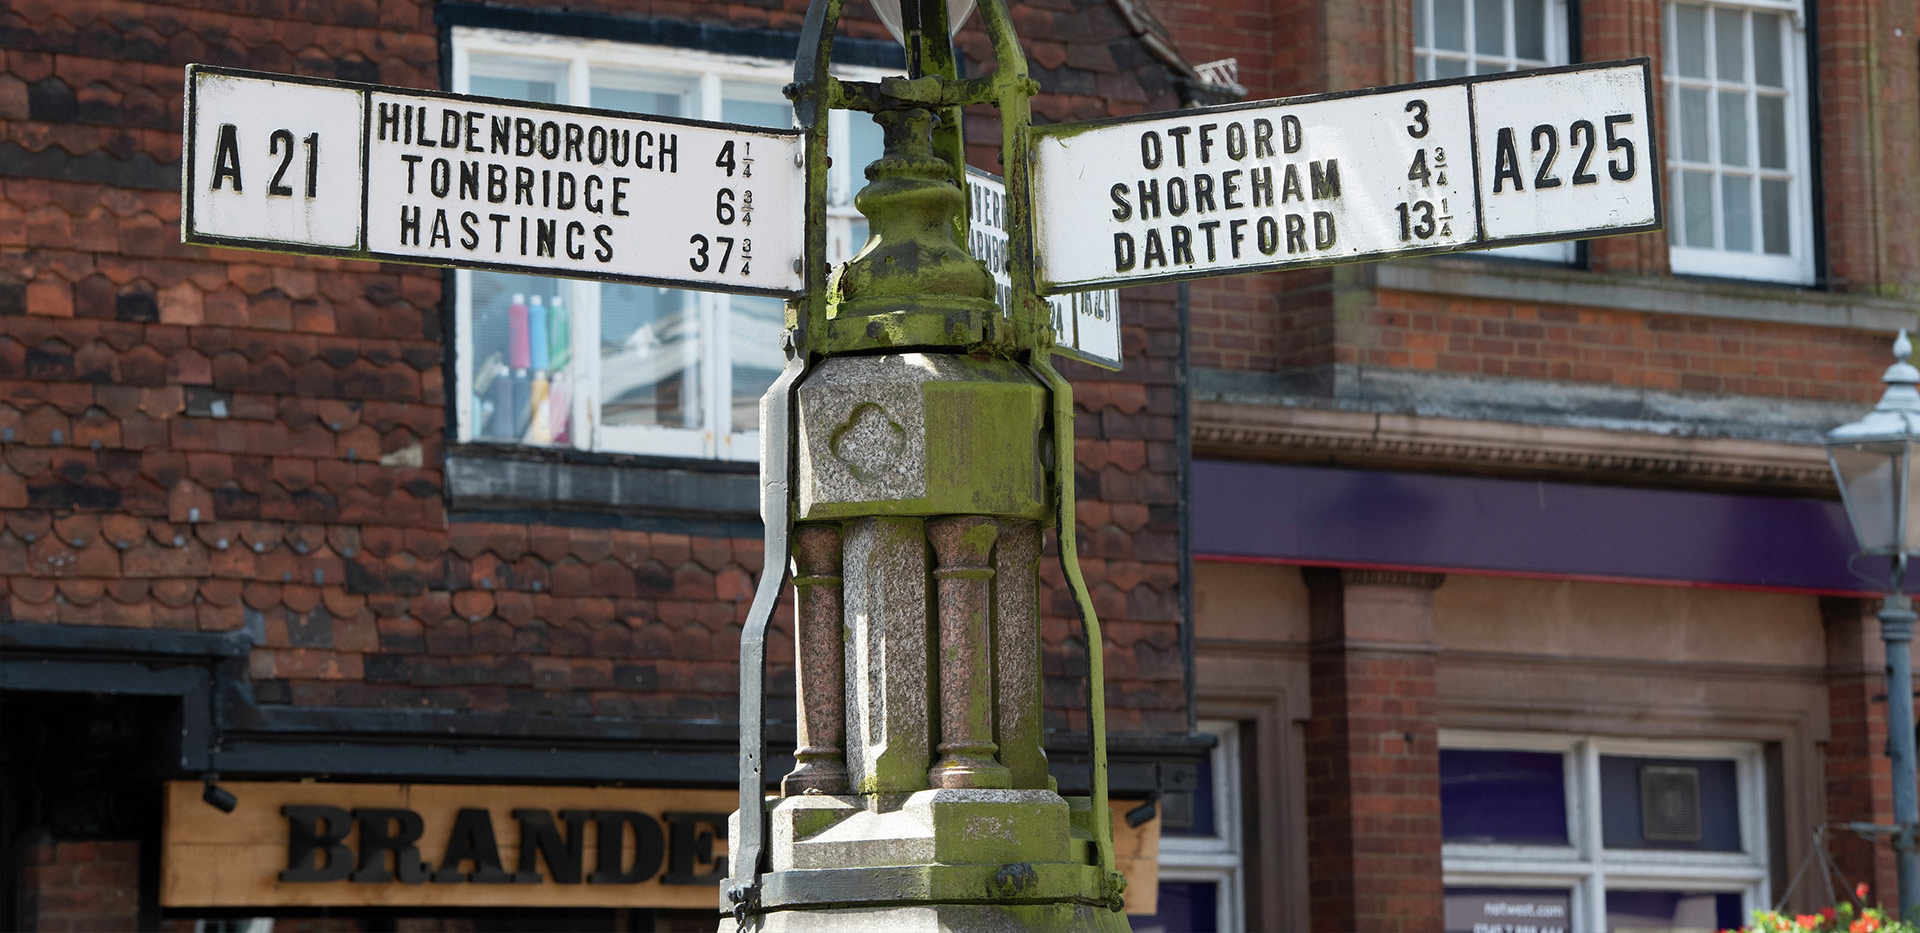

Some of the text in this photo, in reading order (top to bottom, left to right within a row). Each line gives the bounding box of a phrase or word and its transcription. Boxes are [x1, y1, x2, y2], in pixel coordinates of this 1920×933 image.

[210, 123, 319, 199] A 21
[378, 102, 678, 174] HILDENBOROUGH
[1140, 99, 1429, 170] OTFORD 3
[1492, 113, 1636, 195] A225
[400, 154, 631, 217] TONBRIDGE
[1110, 159, 1341, 222] SHOREHAM
[400, 205, 613, 263] HASTINGS
[1113, 211, 1336, 274] DARTFORD
